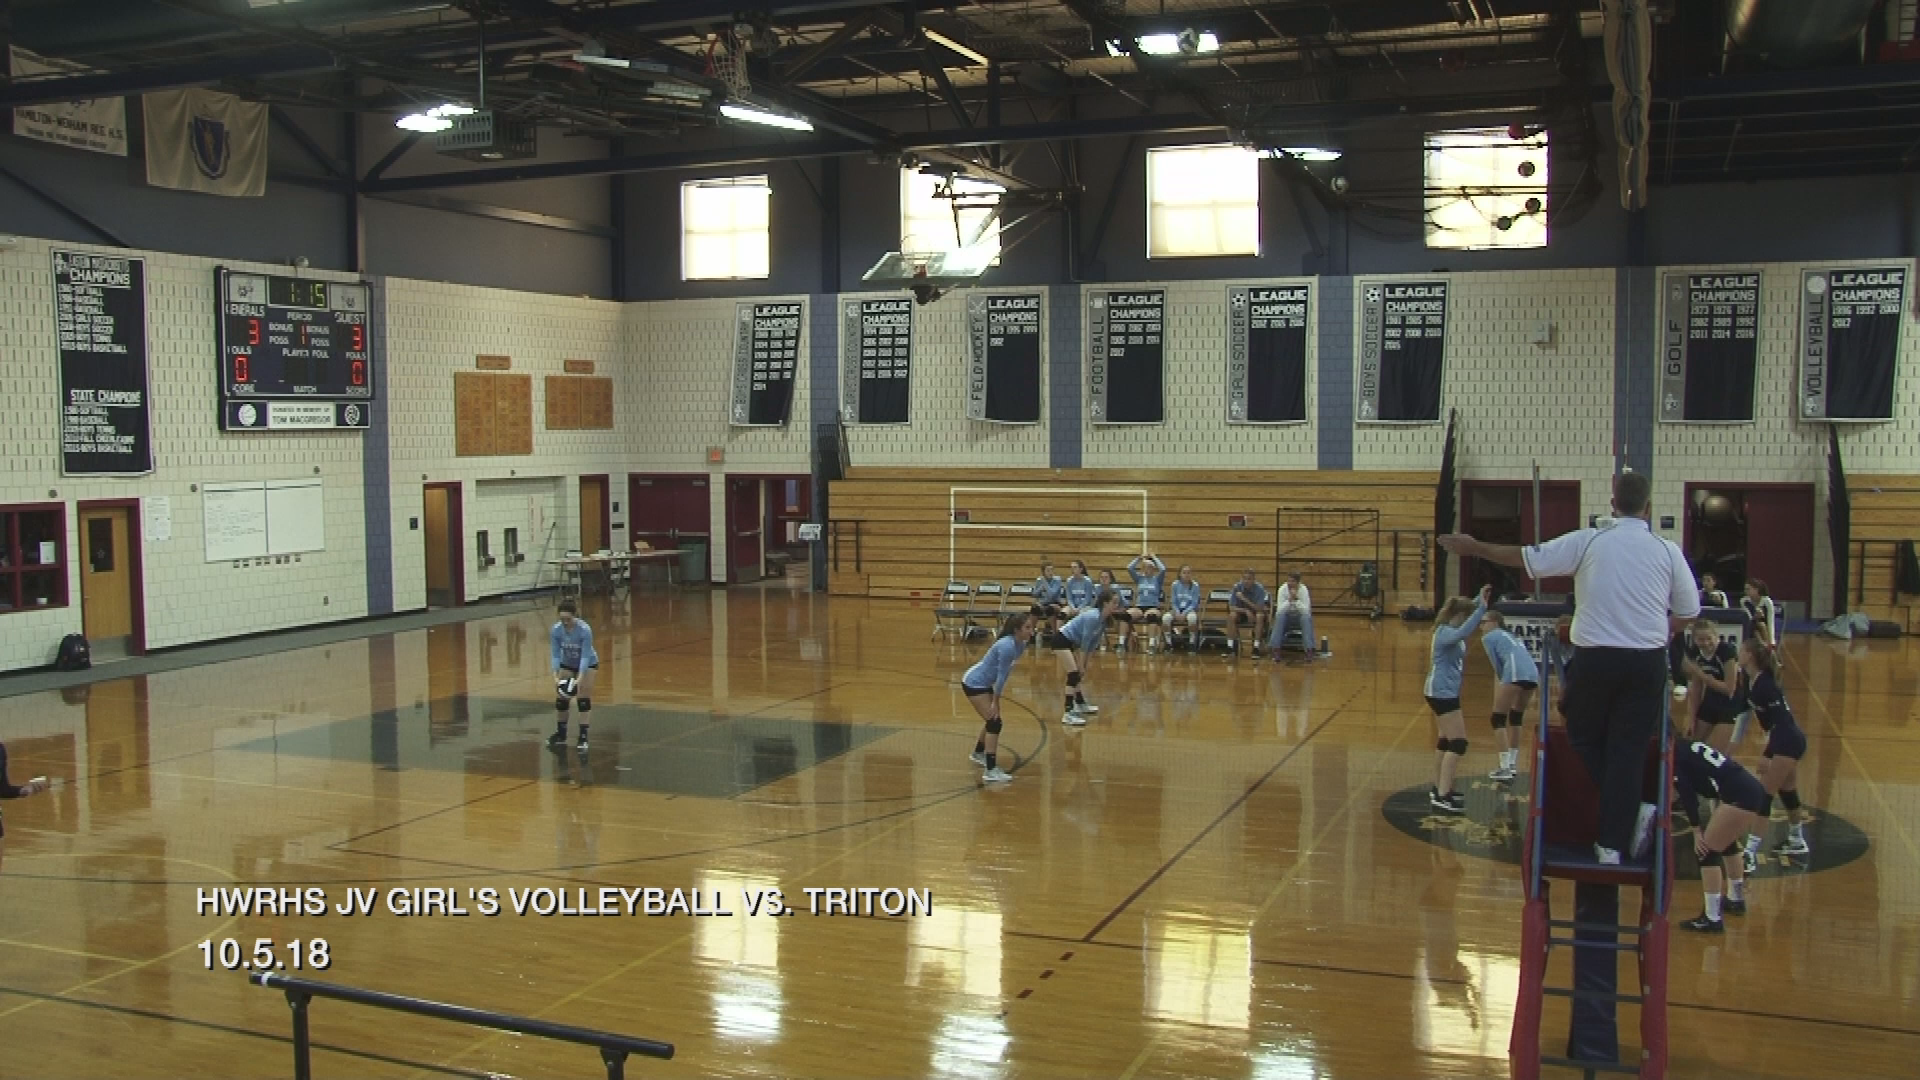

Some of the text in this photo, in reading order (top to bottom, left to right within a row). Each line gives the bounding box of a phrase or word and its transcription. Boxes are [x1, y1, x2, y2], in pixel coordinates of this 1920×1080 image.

[70, 267, 131, 284] CHAMPIONS
[1831, 272, 1903, 286] LEAGUE
[1690, 276, 1758, 289] LEAGUE
[290, 282, 326, 308] 1:15
[1250, 290, 1307, 302] LEAGUE
[1385, 286, 1445, 298] LEAGUE
[1691, 290, 1756, 302] CHAMPIONS
[1832, 288, 1901, 302] CHAMPIONS
[988, 298, 1039, 309] LEAGUE
[1109, 294, 1163, 305] LEAGUE
[226, 303, 266, 318] ENERALS
[755, 306, 800, 317] LEAGUE
[863, 302, 910, 313] LEAGUE
[1110, 307, 1162, 318] CHAMPIONS
[1251, 303, 1305, 315] CHAMPIONS
[1386, 301, 1443, 312] CHAMPIONS
[1691, 305, 1709, 315] 1973
[1736, 304, 1756, 315] 1977
[286, 311, 313, 321] PERIOD
[863, 313, 910, 326] CHAMPIONS
[989, 311, 1038, 323] CHAMPIONS
[268, 322, 294, 333] BONUS
[754, 317, 799, 329] CHAMPIONS
[248, 318, 261, 346] 3
[306, 324, 330, 335] BONUS
[1690, 329, 1708, 339] 2011
[1711, 329, 1731, 339] 2014
[268, 335, 290, 346] POSS
[311, 337, 331, 348] POSS
[352, 326, 363, 351] 3
[227, 345, 252, 356] OULS
[1668, 319, 1682, 376] GOLF
[1807, 294, 1823, 398] VOLLEYBALL
[311, 349, 330, 359] FOUL
[345, 351, 367, 361] FOULS
[1091, 315, 1104, 395] FOOTBALL
[1231, 309, 1245, 399] GIRLS SOCCER
[1362, 307, 1378, 398] BOYS SOCCER
[971, 316, 985, 402] FIELD HOCKEY
[234, 357, 249, 384] 0
[351, 360, 364, 386] 0
[70, 389, 95, 402] STATE
[292, 385, 318, 395] MATCH
[345, 386, 368, 396] SCORE
[272, 415, 331, 425] TOM MACGREGOR
[1691, 741, 1727, 768] 2
